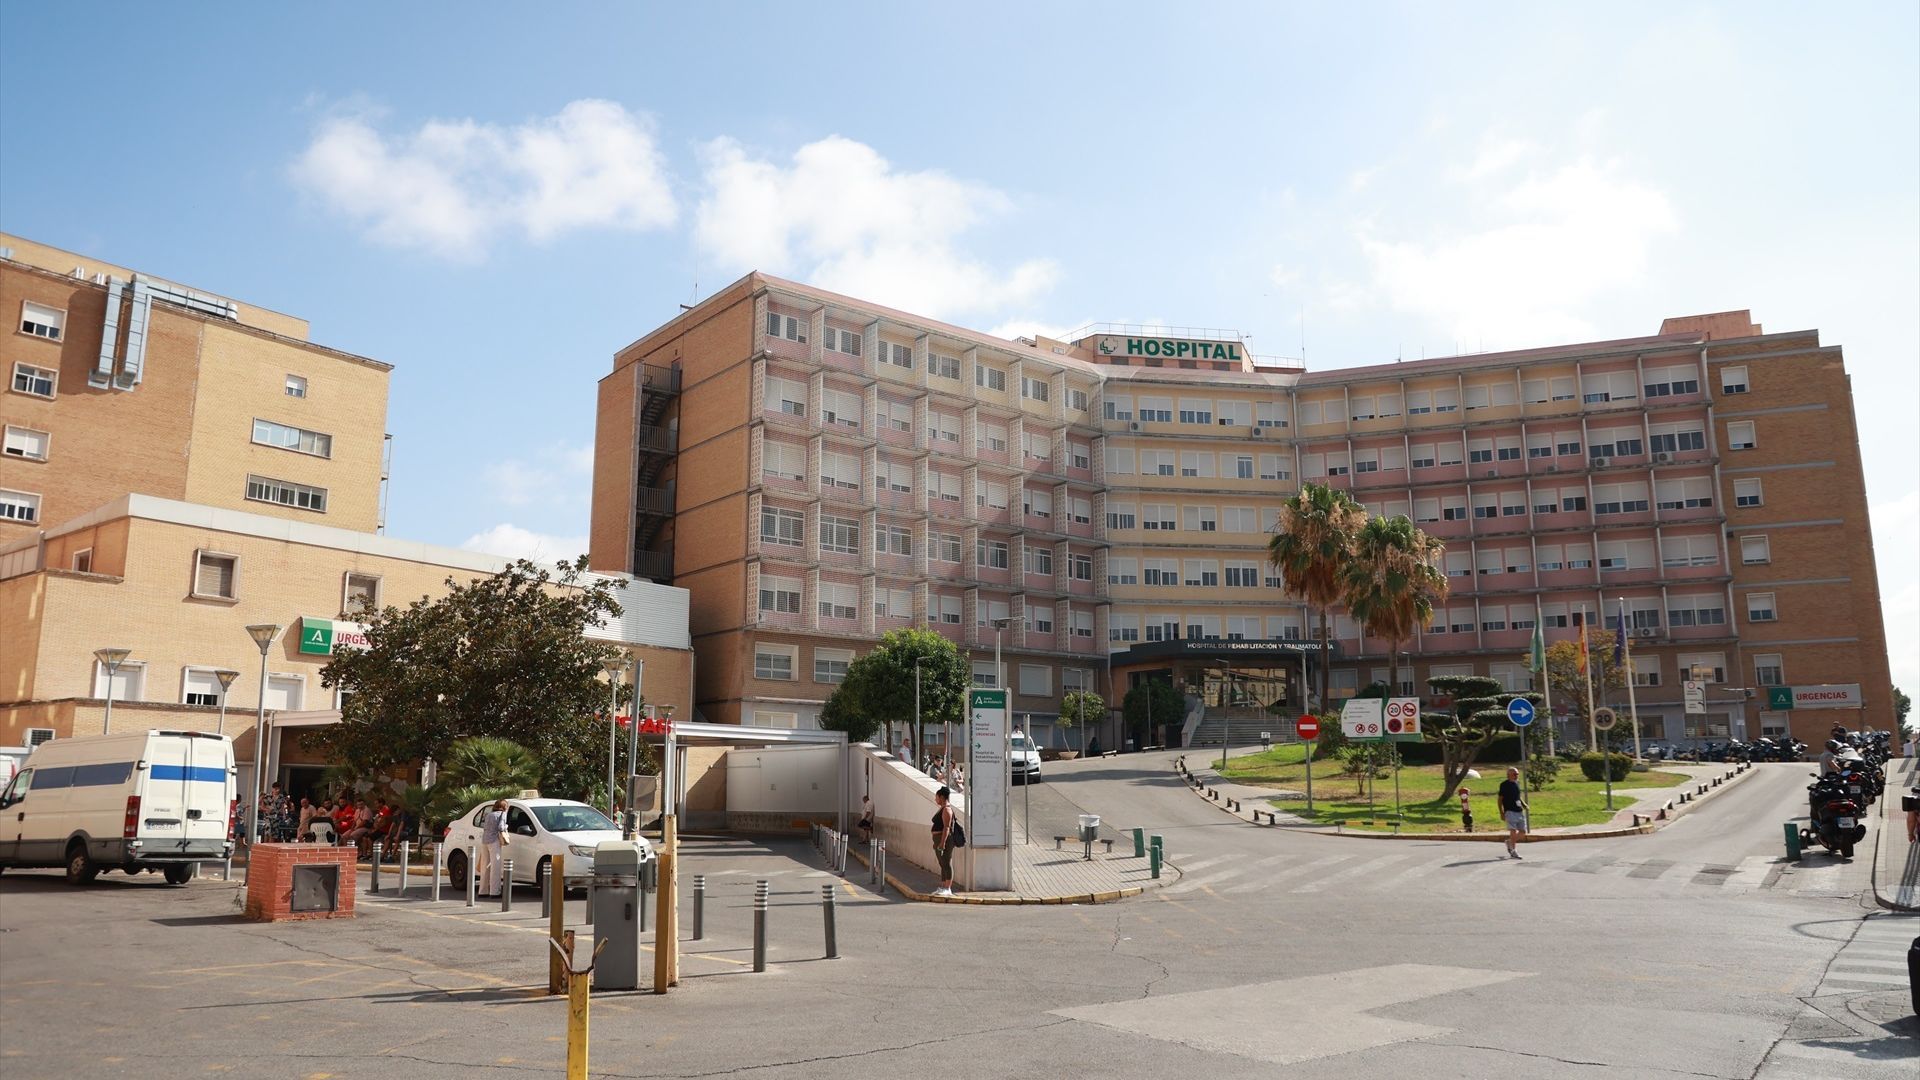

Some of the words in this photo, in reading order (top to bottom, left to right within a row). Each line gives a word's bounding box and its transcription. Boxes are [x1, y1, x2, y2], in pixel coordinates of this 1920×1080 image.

[1127, 338, 1241, 361] HOSPITAL
[1796, 691, 1848, 701] URGENCIAS
[1390, 706, 1399, 714] 20
[1596, 714, 1611, 723] 20
